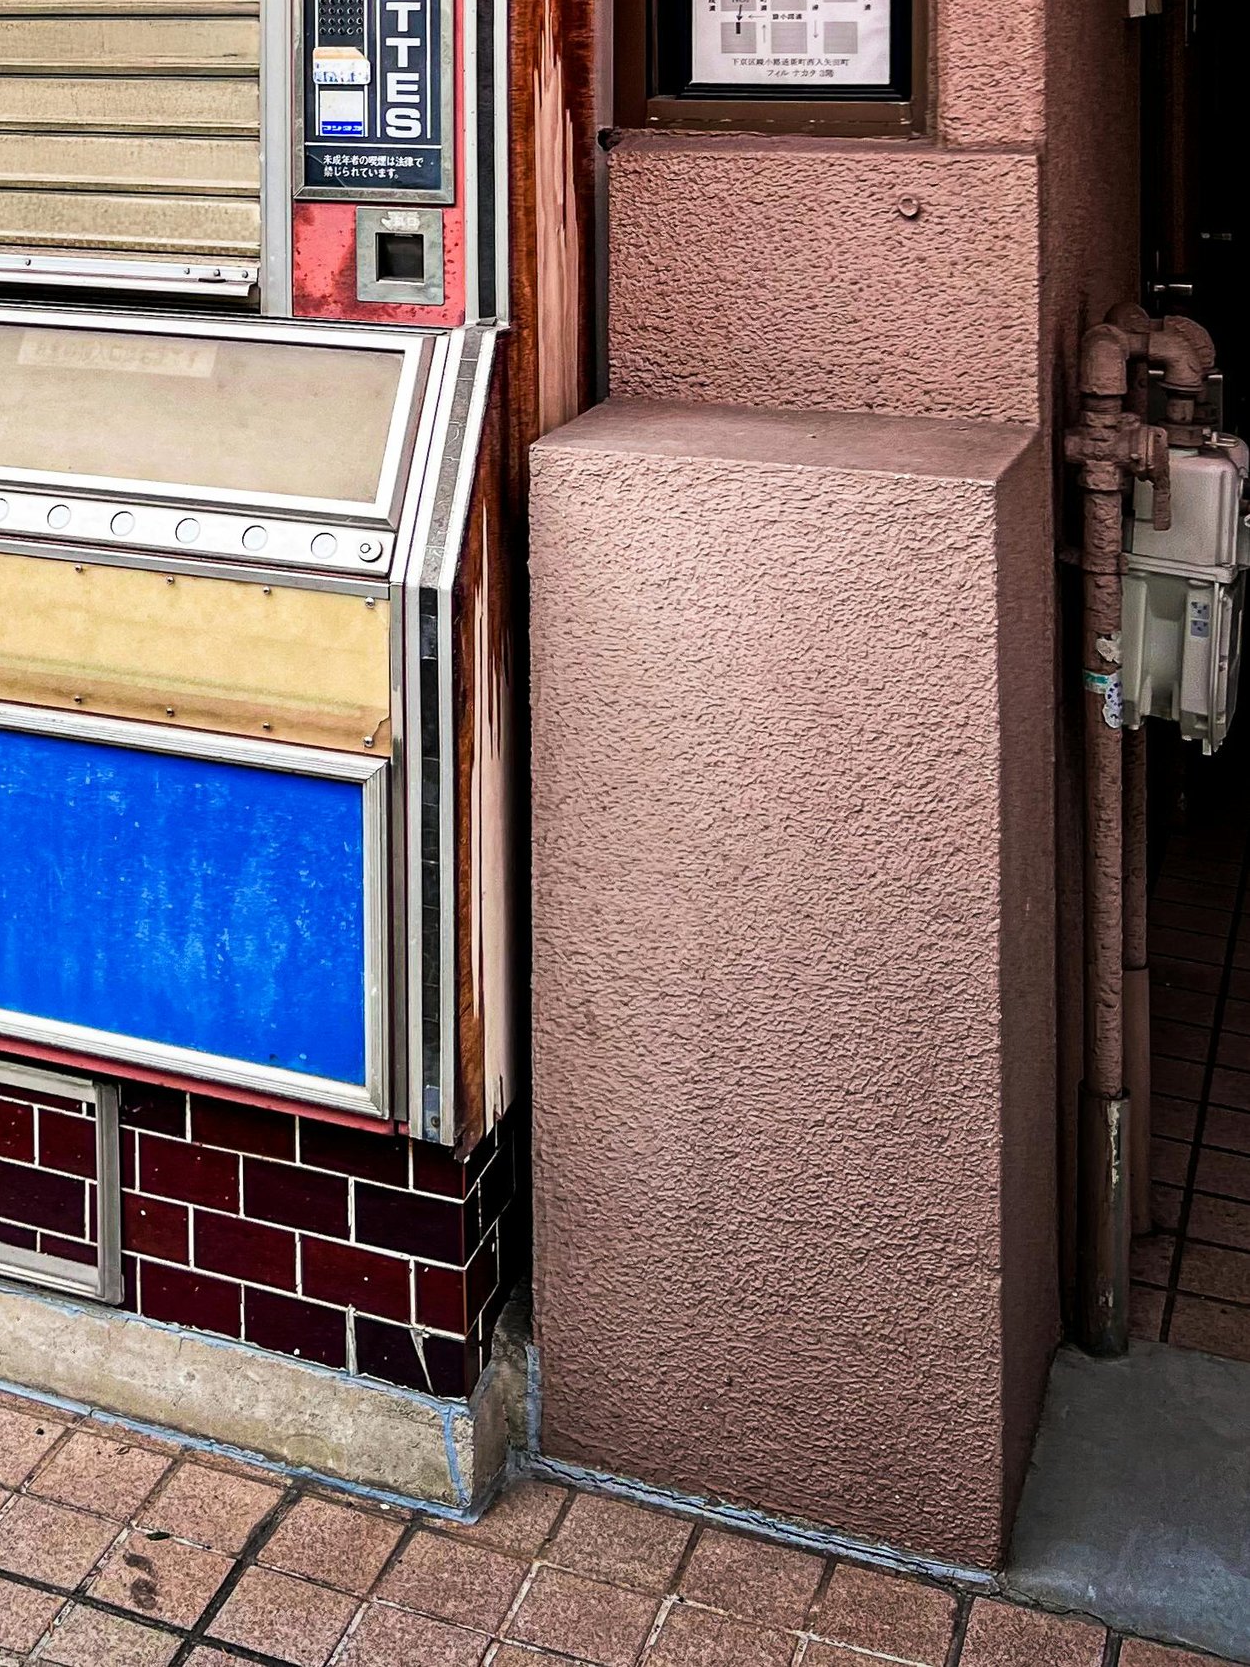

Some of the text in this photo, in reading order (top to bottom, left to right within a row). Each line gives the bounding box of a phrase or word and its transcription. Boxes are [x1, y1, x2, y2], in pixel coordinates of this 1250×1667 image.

[323, 154, 424, 168] 未成年者の喫煙は法律で
[323, 167, 399, 179] 禁じられています。
